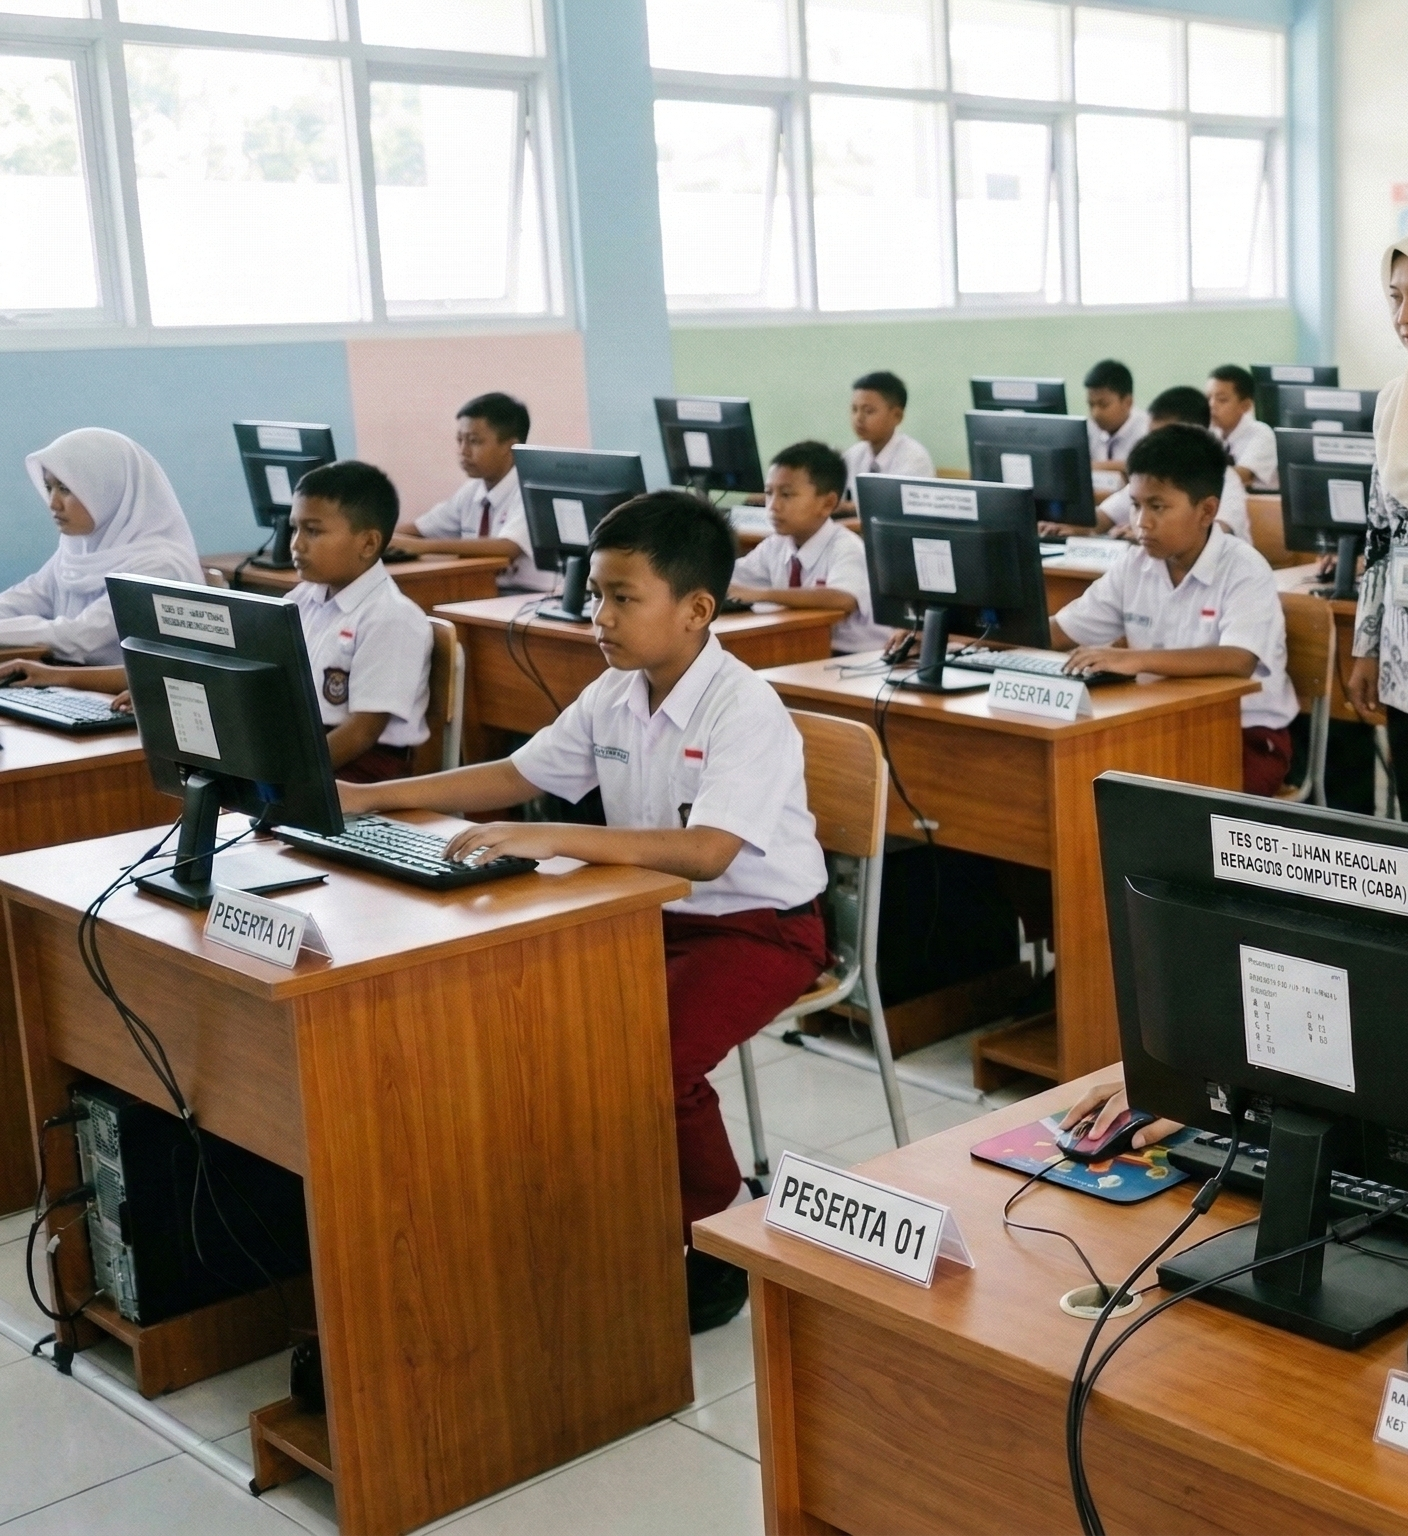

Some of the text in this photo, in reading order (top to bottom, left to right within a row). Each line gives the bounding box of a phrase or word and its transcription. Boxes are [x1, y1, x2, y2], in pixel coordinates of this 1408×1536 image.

[994, 681, 1073, 709] PESERTA 02
[1229, 831, 1252, 848] TES
[1256, 836, 1279, 854] CBT
[1287, 864, 1357, 891] COMPUTER
[1362, 878, 1407, 905] (CABA)
[213, 902, 296, 951] PESERTA 01
[779, 1176, 926, 1260] PESERTA 01
